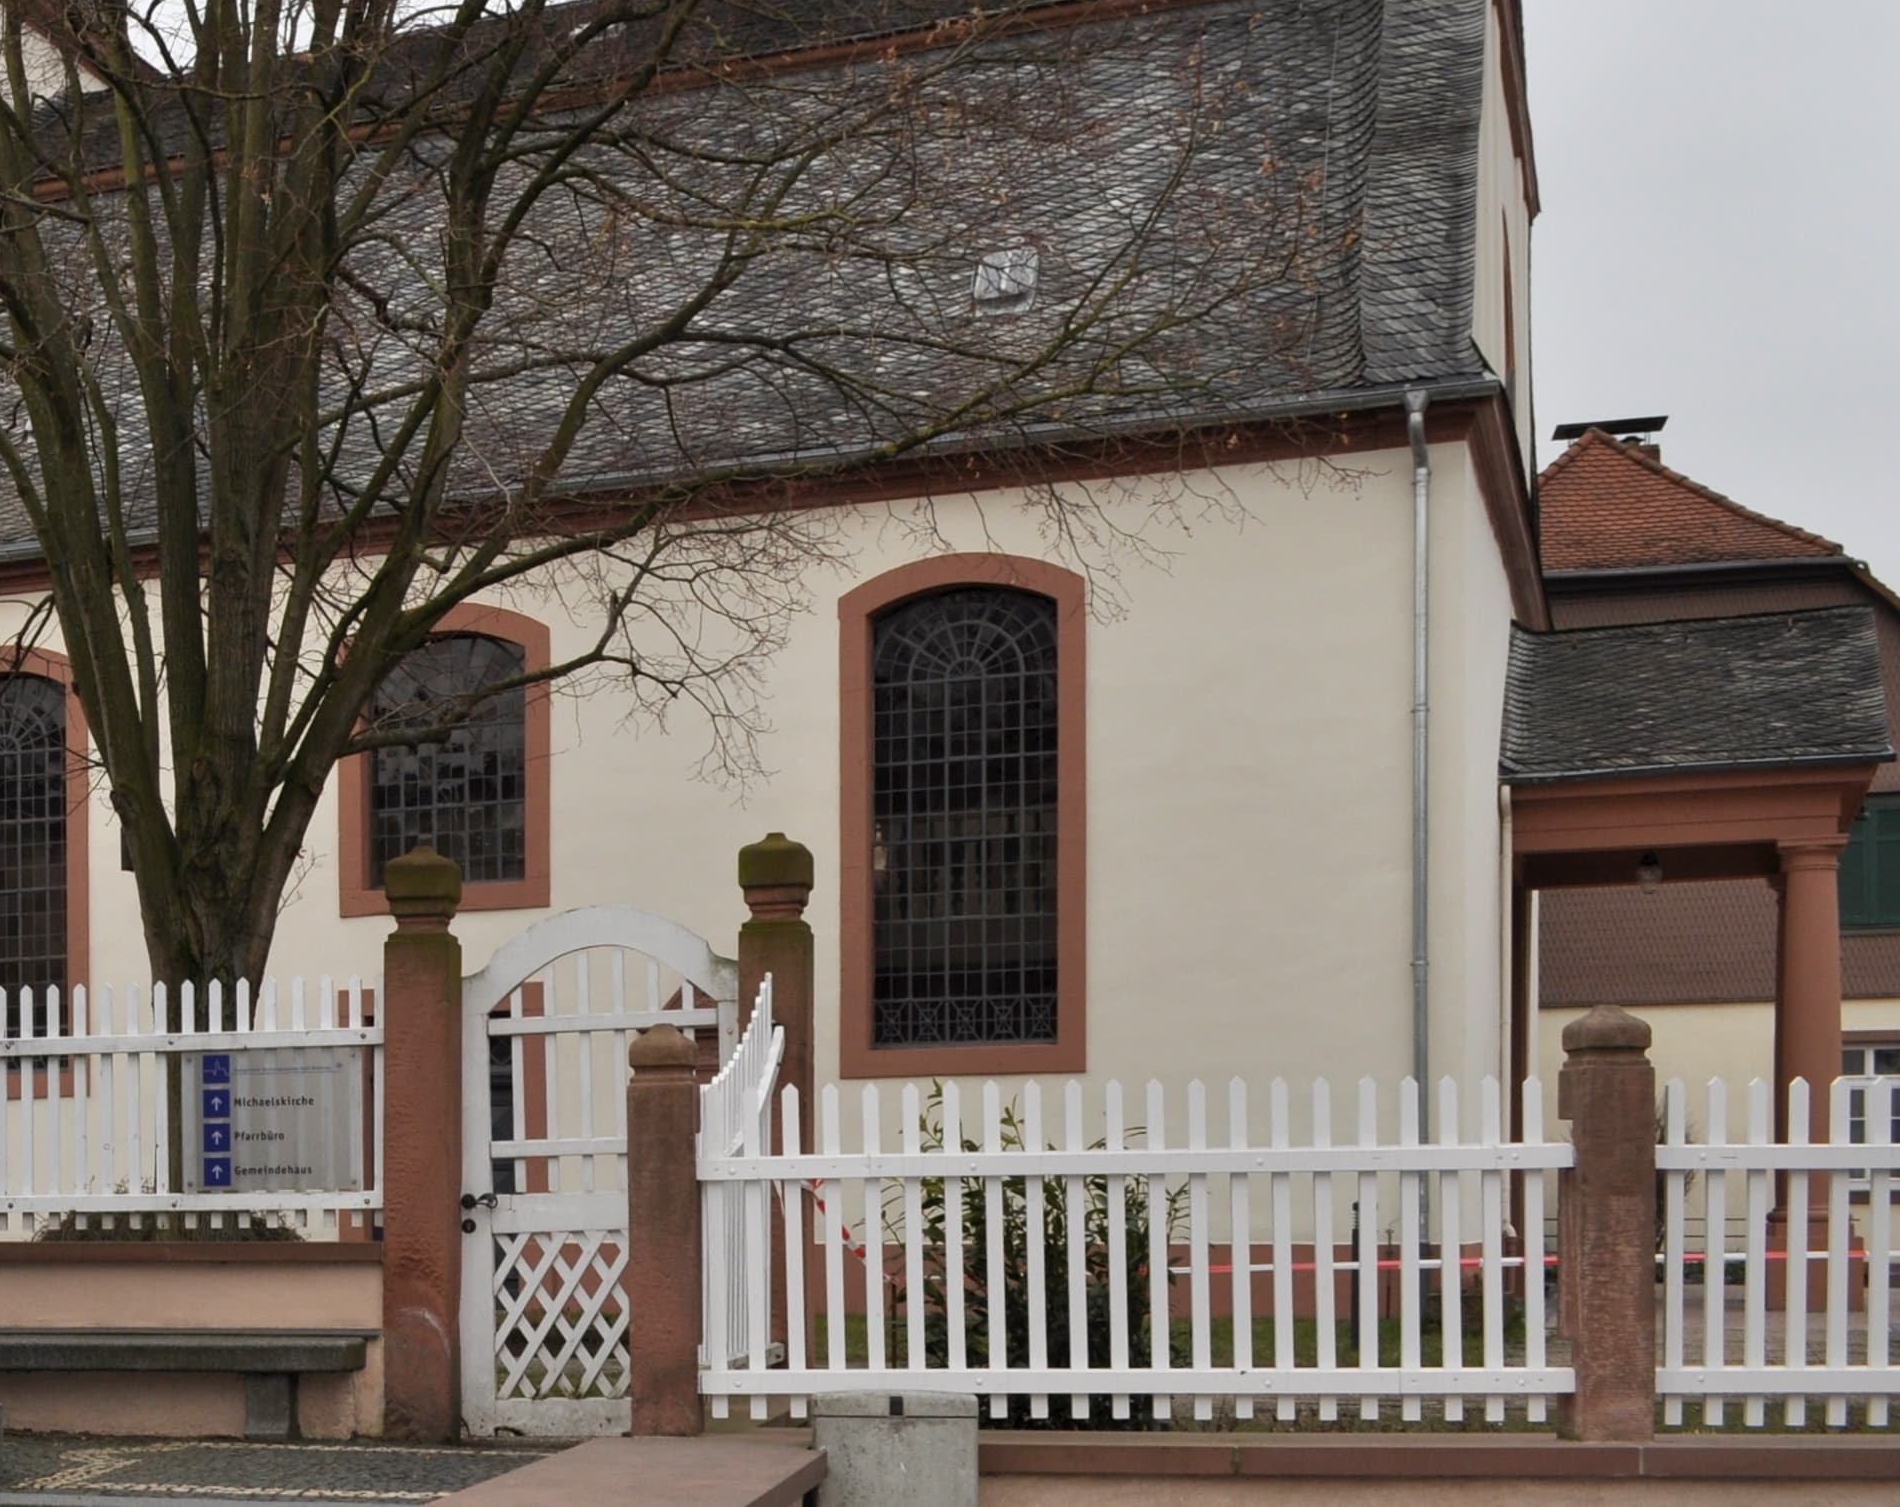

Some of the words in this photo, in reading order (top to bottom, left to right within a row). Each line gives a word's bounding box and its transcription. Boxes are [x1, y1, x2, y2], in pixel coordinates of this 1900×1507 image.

[233, 1095, 315, 1107] Michaelskirche
[233, 1130, 285, 1141] Pfarrbüro
[233, 1164, 313, 1176] Gemeindehaus
